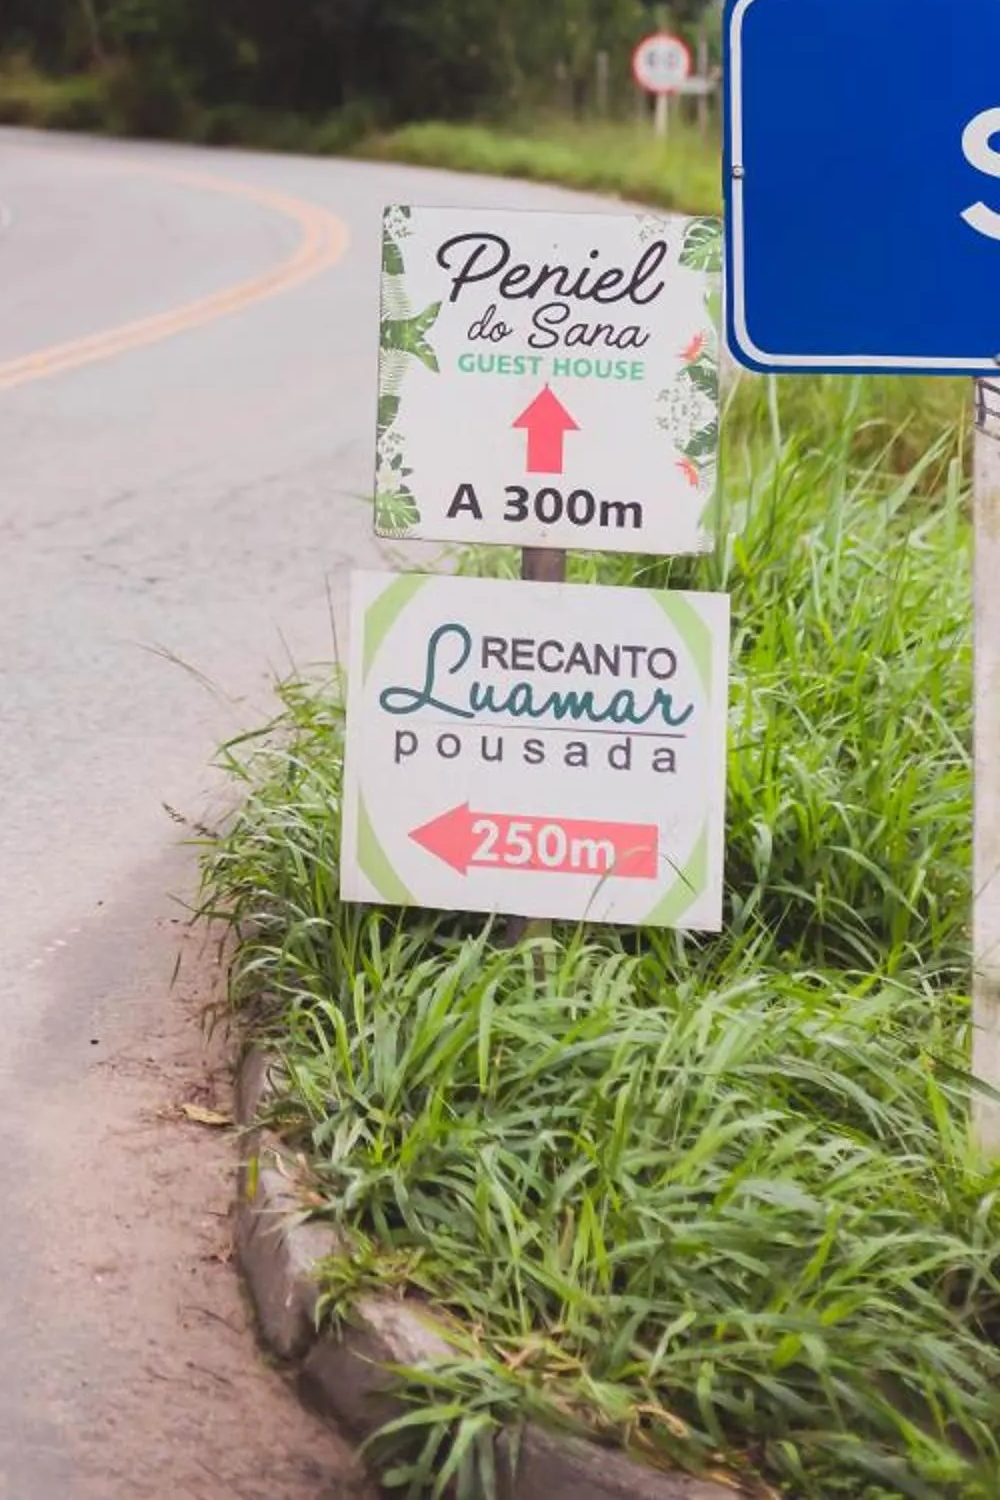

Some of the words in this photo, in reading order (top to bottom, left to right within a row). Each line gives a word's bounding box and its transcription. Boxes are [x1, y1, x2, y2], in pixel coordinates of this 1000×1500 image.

[436, 232, 668, 306] Peniel
[467, 304, 513, 342] do
[527, 302, 651, 349] Sana
[457, 353, 545, 376] GUEST
[552, 359, 645, 381] HOUSE
[446, 483, 483, 520] A
[503, 485, 643, 529] 300m
[379, 623, 695, 727] Luamar
[481, 636, 678, 681] RECANTO
[394, 729, 677, 773] pousada
[471, 818, 616, 870] 250m
